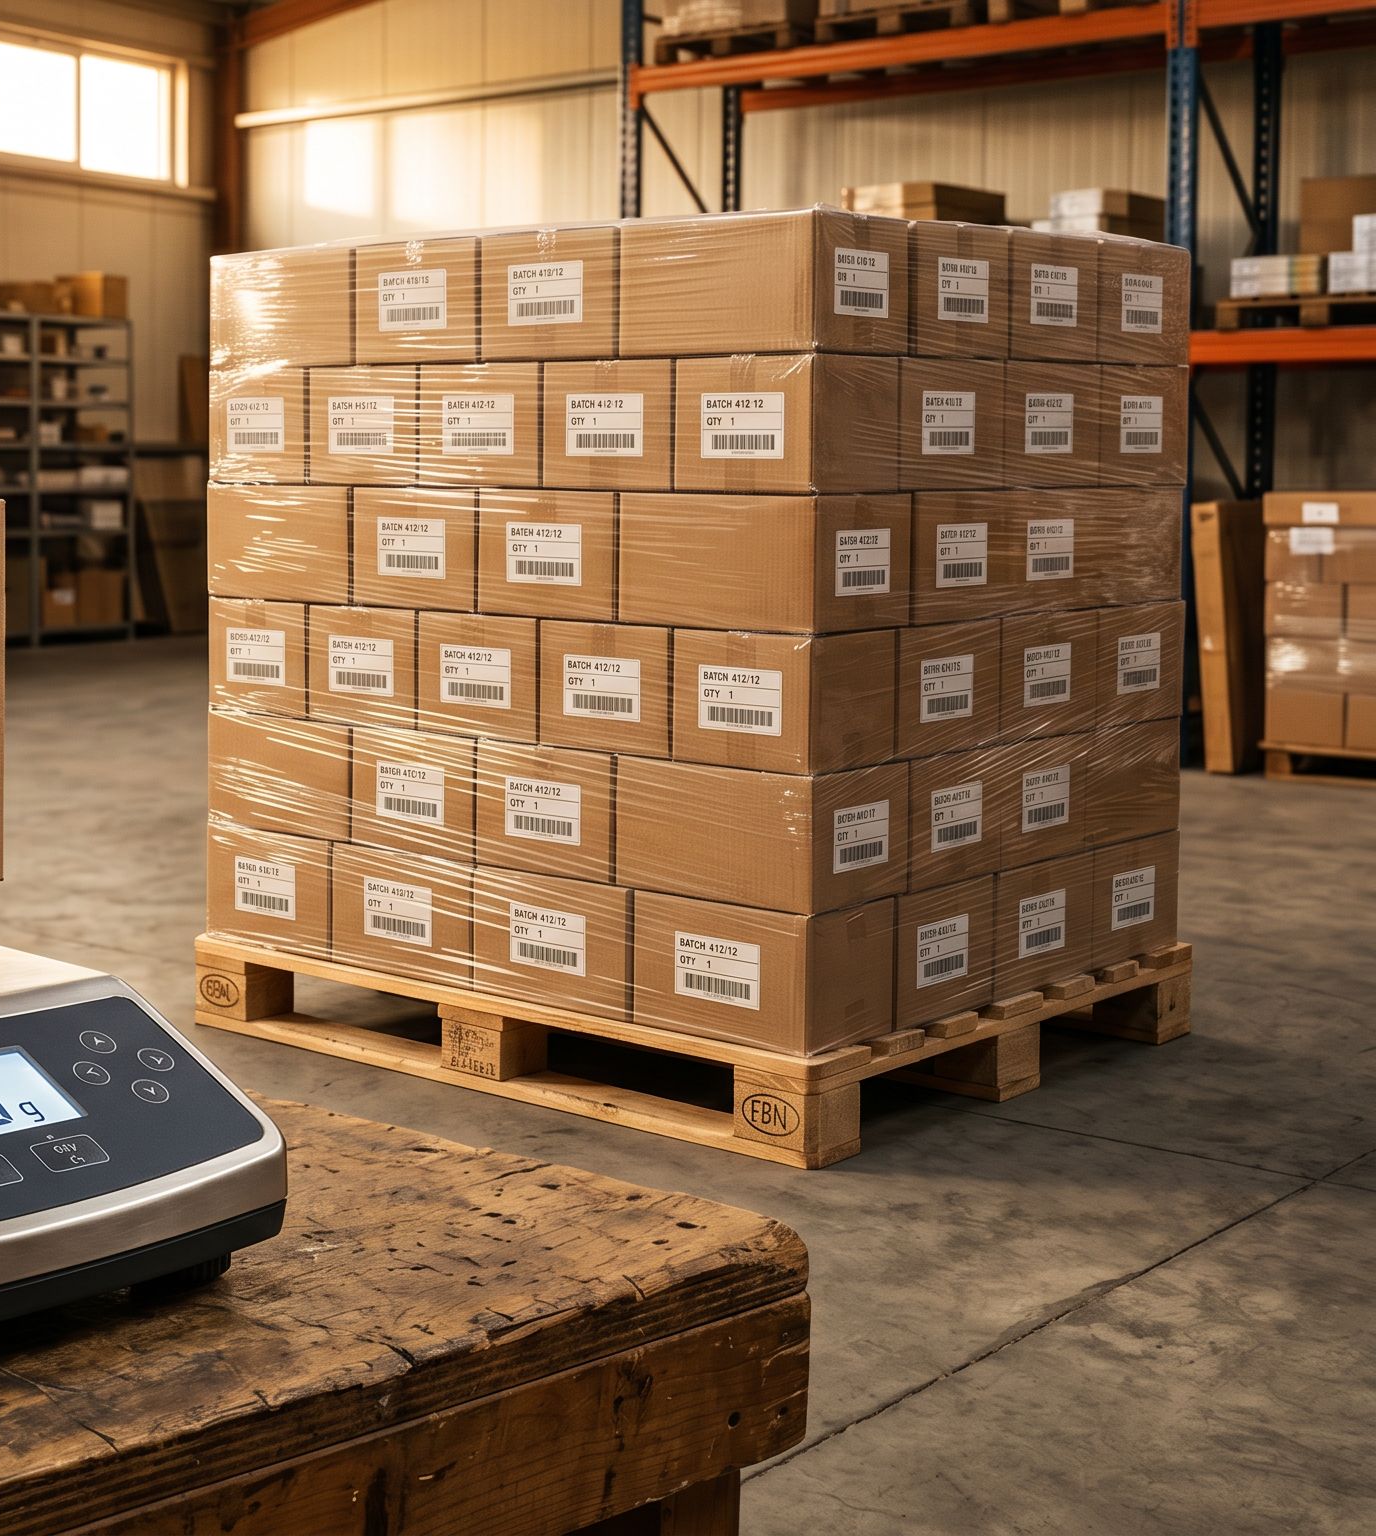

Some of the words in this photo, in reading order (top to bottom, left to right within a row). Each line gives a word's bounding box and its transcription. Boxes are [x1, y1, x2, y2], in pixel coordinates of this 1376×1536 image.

[513, 270, 536, 280] BATCH
[535, 285, 539, 294] 1
[401, 292, 405, 300] 1
[571, 400, 595, 409] BATCH
[597, 400, 623, 408] 41212
[706, 400, 732, 409] BATCH
[467, 417, 471, 425] 1
[593, 417, 597, 425] 1
[730, 417, 735, 426] 1
[401, 539, 406, 547] 1
[534, 544, 538, 553] 1
[351, 657, 355, 665] 1
[467, 652, 492, 662] 412/12
[465, 667, 469, 675] 1
[568, 660, 591, 670] BATCH
[594, 662, 620, 673] 412/12
[591, 678, 595, 687] 1
[732, 674, 760, 685] 412/12
[728, 690, 733, 699] 1
[401, 784, 405, 792] 1
[510, 782, 533, 793] BATCH
[535, 785, 561, 797] 412/12
[534, 801, 538, 810] 1
[389, 903, 393, 911] 1
[514, 908, 537, 921] BATCH
[540, 914, 566, 927] 412/12
[537, 930, 542, 938] 1
[680, 938, 705, 950] BATCH
[709, 943, 737, 956] 412/12
[706, 960, 711, 969] 1
[18, 1101, 45, 1122] g
